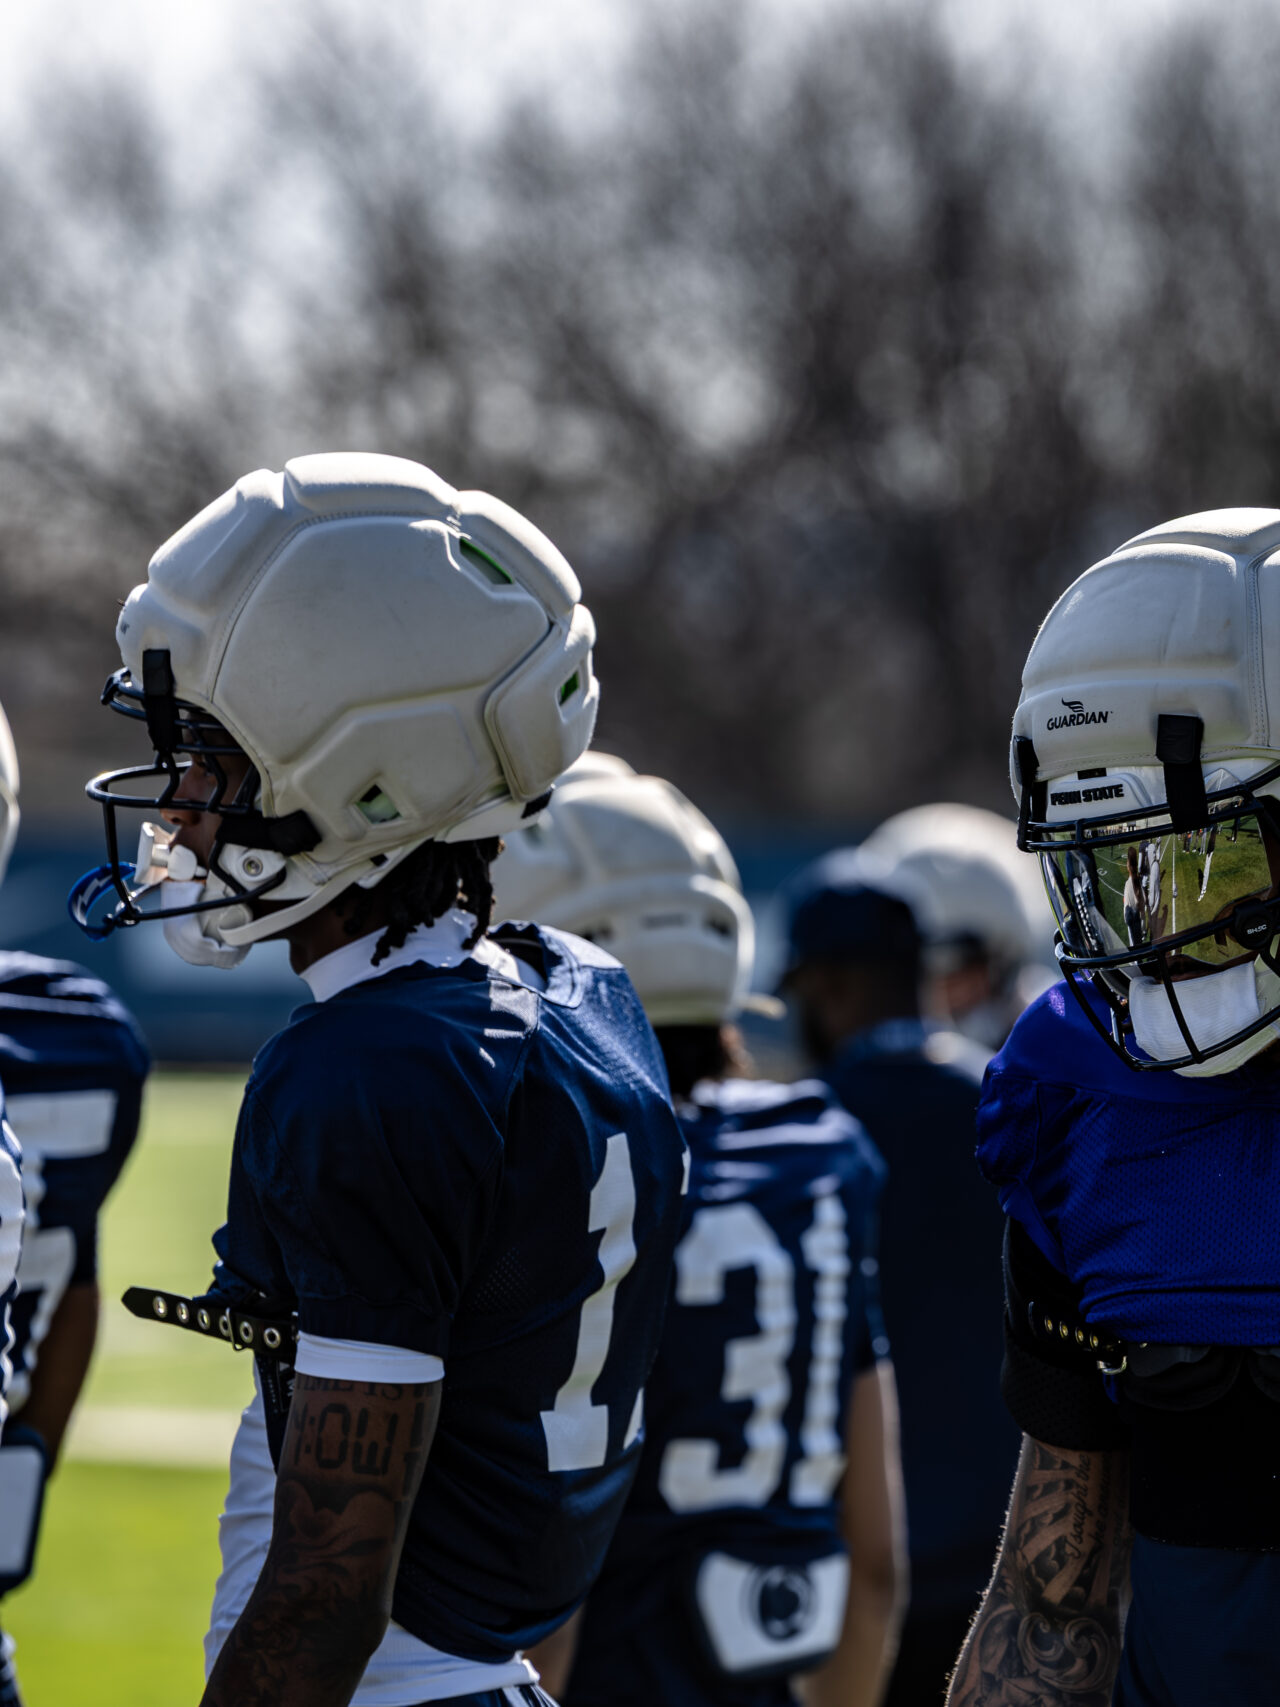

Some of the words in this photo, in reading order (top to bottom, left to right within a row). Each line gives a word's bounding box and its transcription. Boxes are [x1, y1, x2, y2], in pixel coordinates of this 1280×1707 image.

[1047, 710, 1109, 731] GUARDIAN
[1050, 789, 1081, 806] PENN
[1082, 783, 1125, 803] STATE
[658, 1178, 850, 1515] 31
